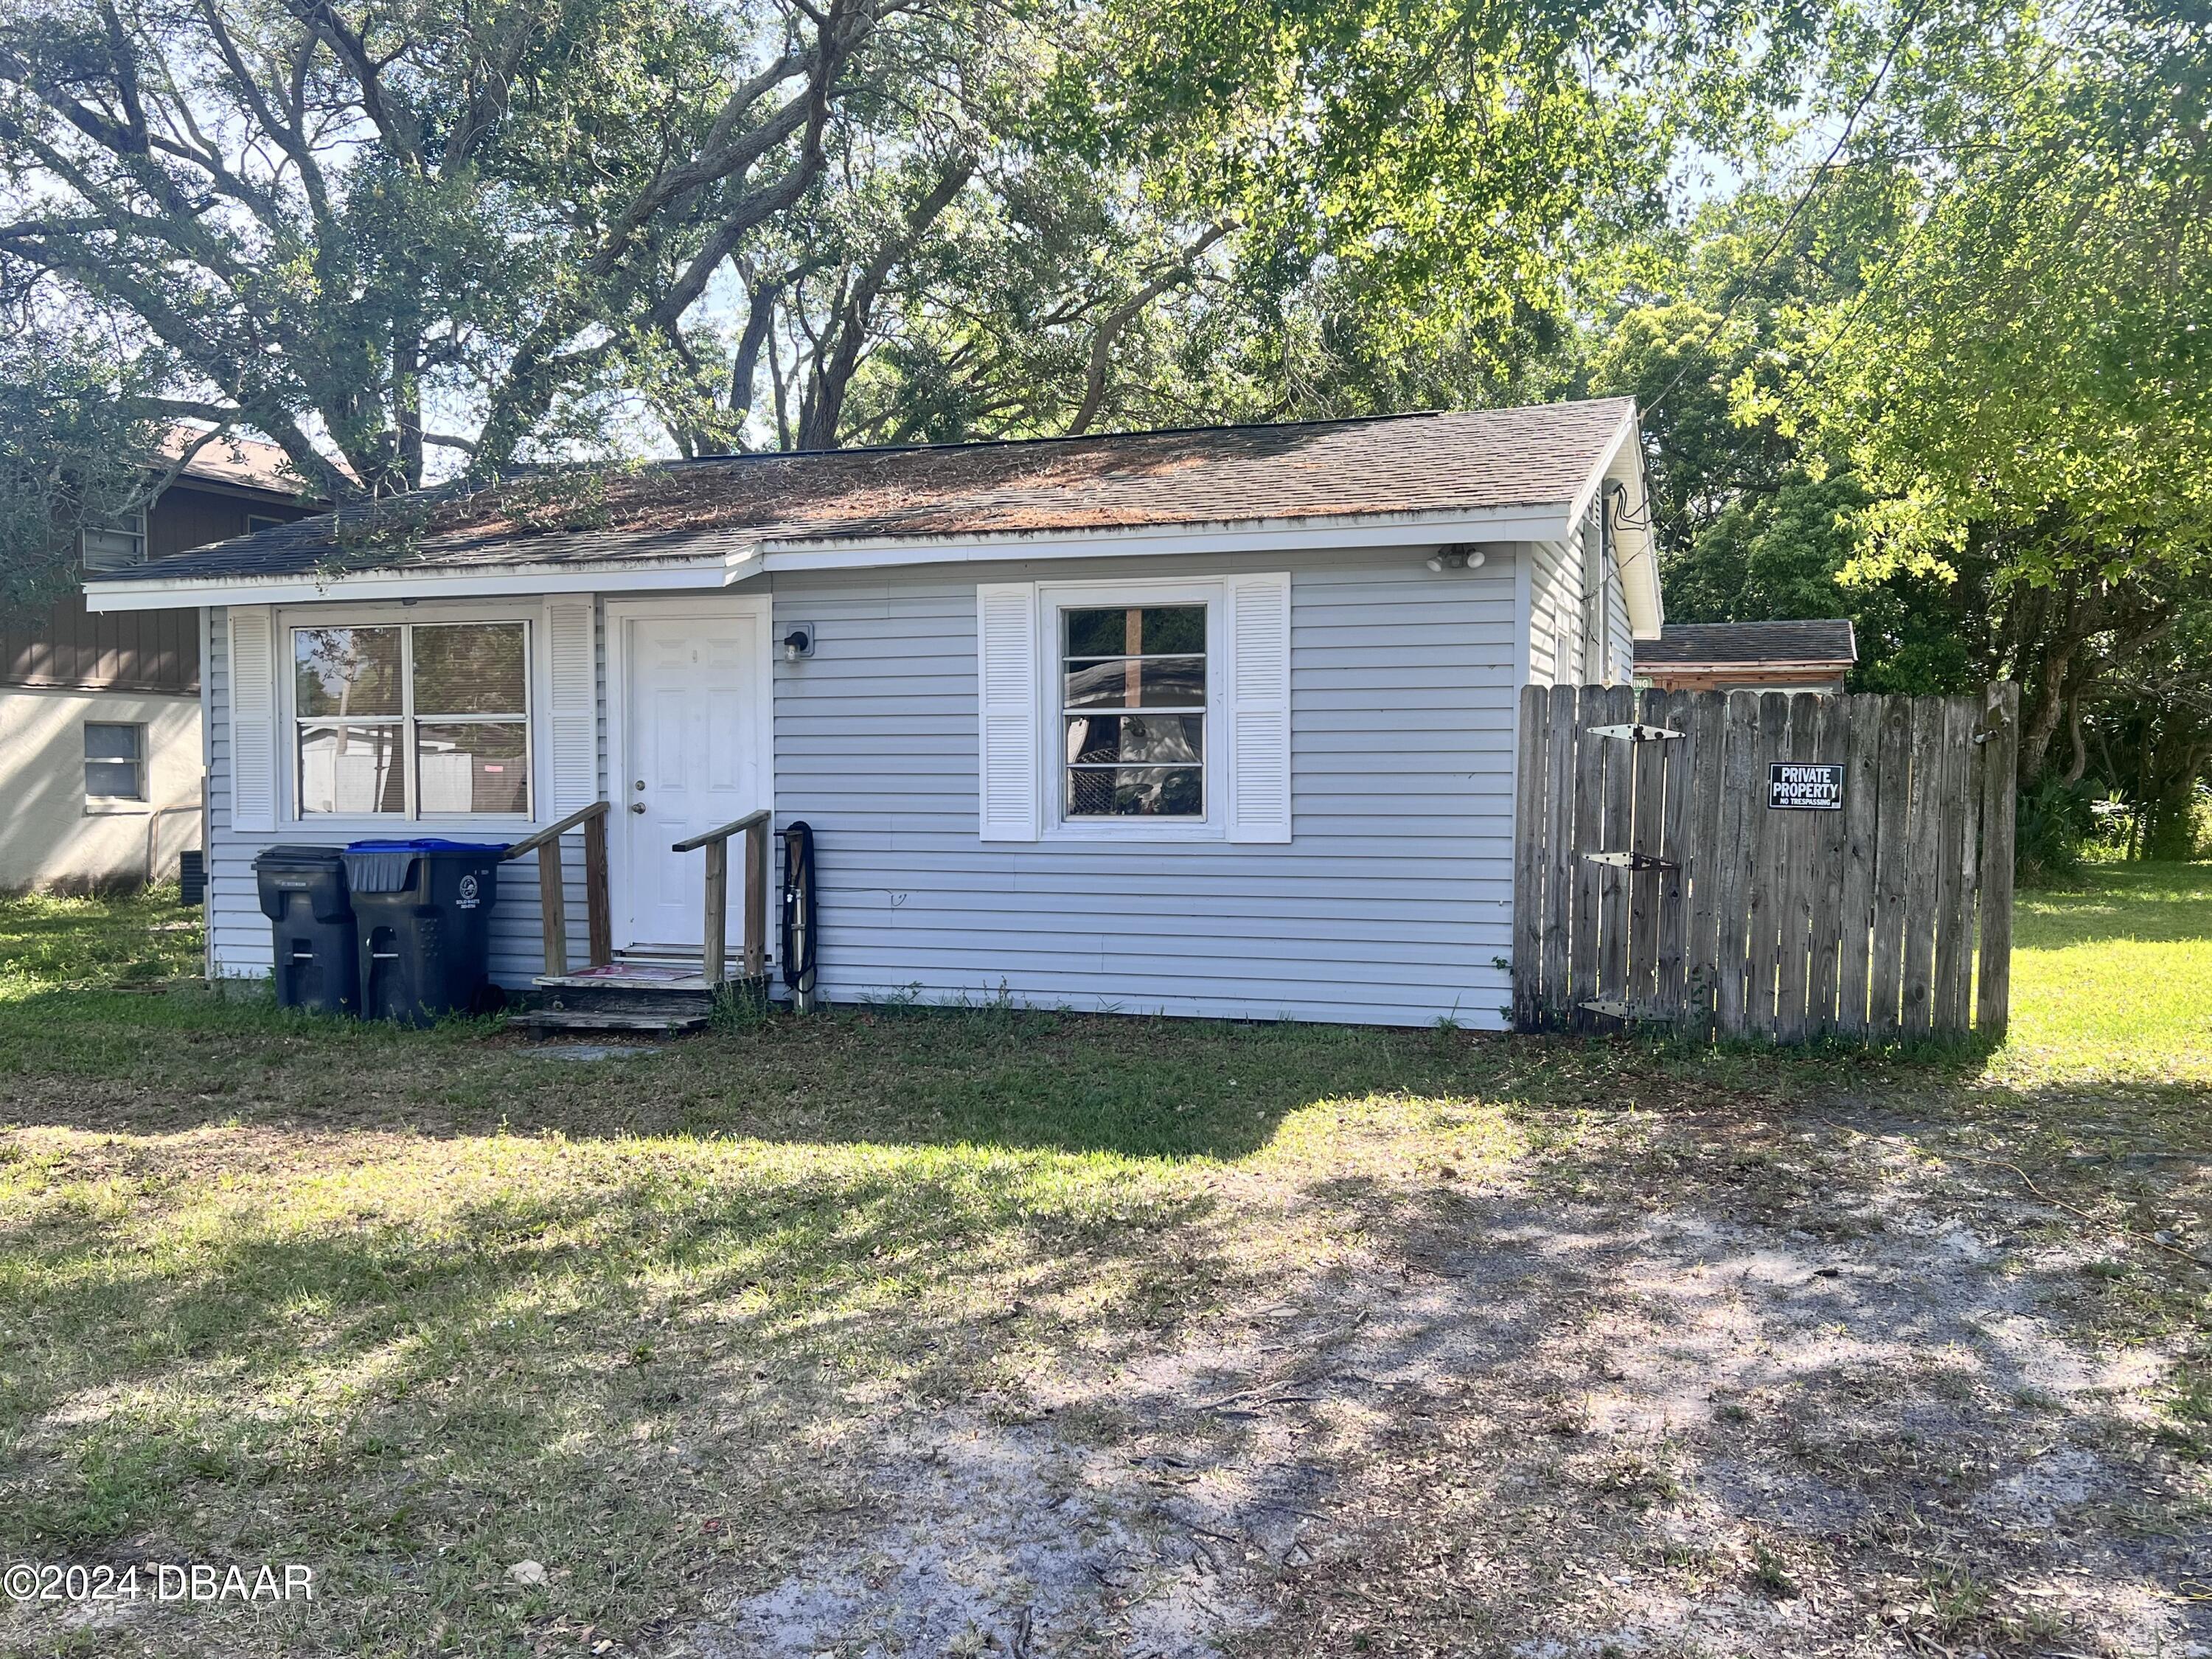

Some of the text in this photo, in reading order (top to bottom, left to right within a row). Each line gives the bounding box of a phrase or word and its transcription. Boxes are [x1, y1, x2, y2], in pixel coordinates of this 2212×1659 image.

[1633, 679, 1649, 688] ING
[1781, 768, 1831, 783] PRIVATE
[1773, 782, 1838, 798] PROPERTY
